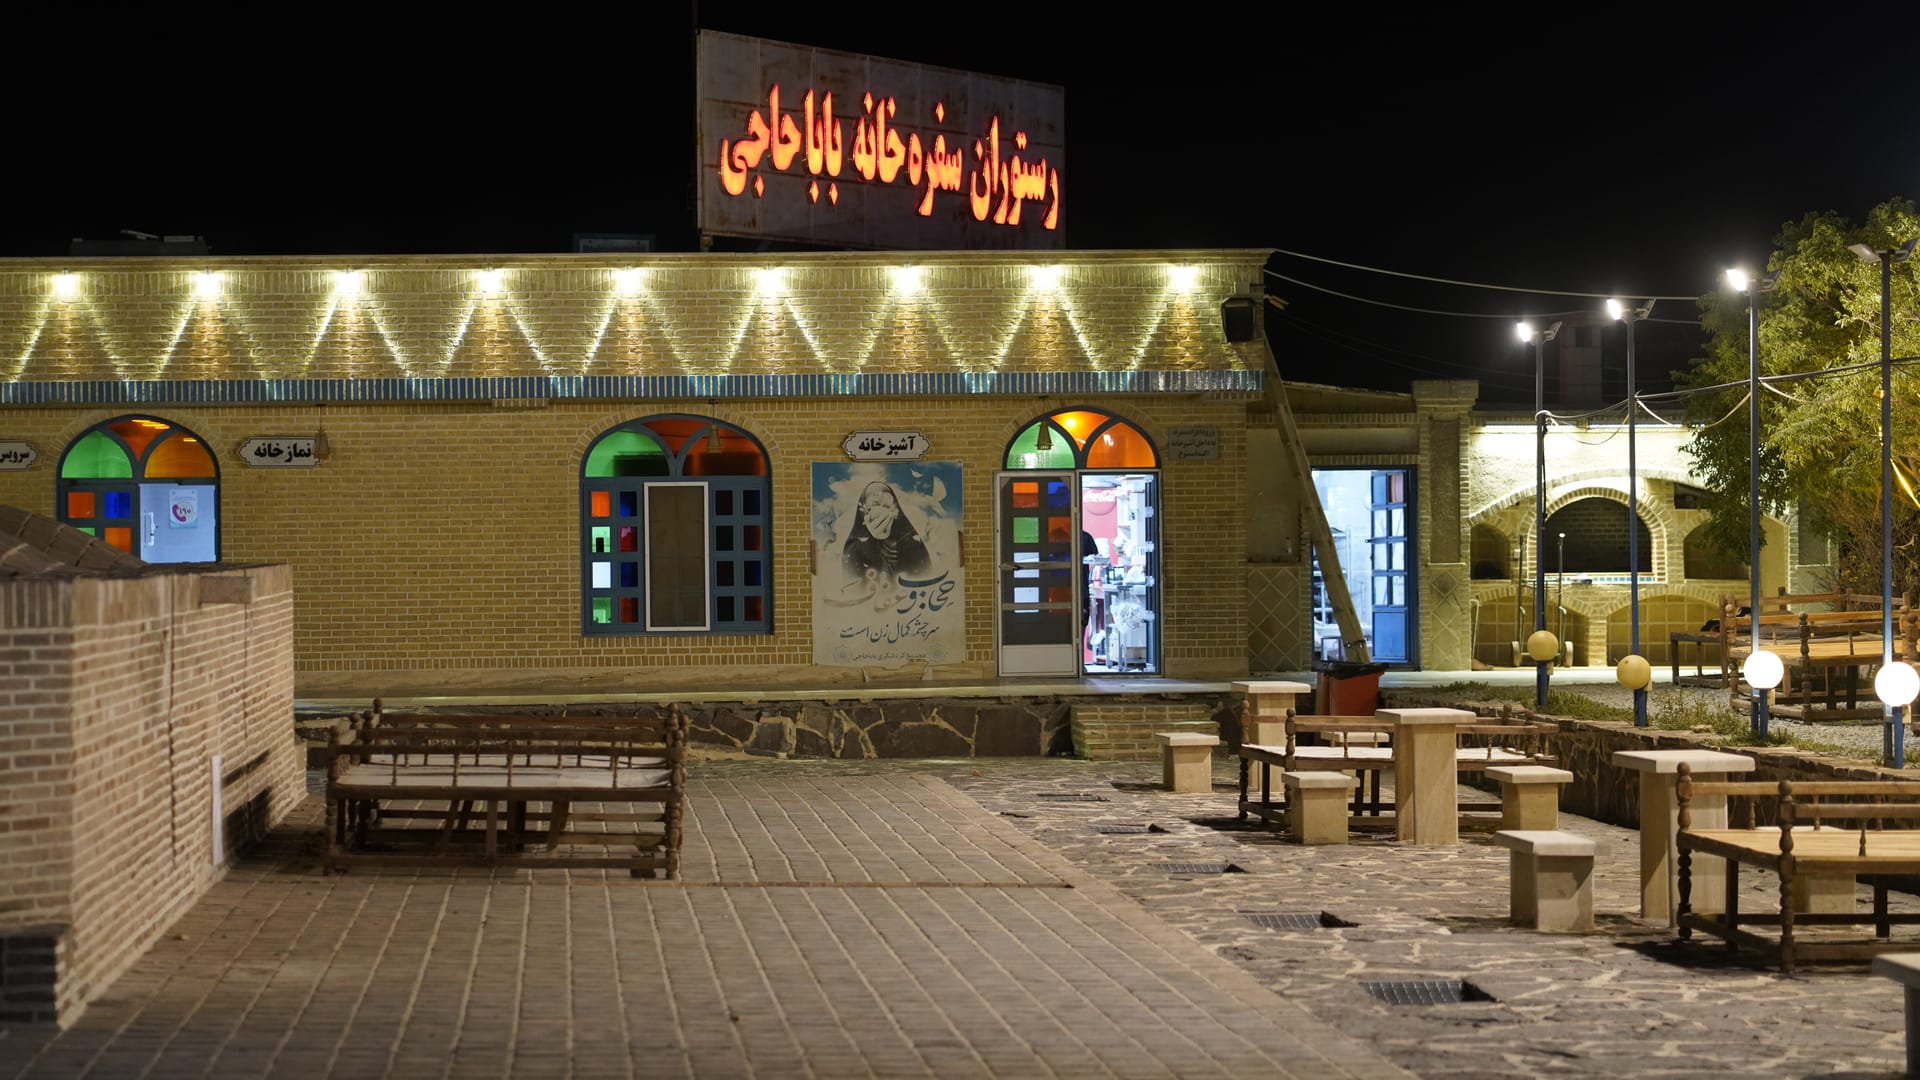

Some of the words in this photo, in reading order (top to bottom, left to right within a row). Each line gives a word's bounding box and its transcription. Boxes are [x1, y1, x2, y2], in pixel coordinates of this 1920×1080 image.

[970, 115, 1059, 230] رستوران
[897, 590, 917, 614] و
[898, 569, 956, 612] حجاب
[840, 625, 870, 639] است
[870, 623, 889, 643] زن
